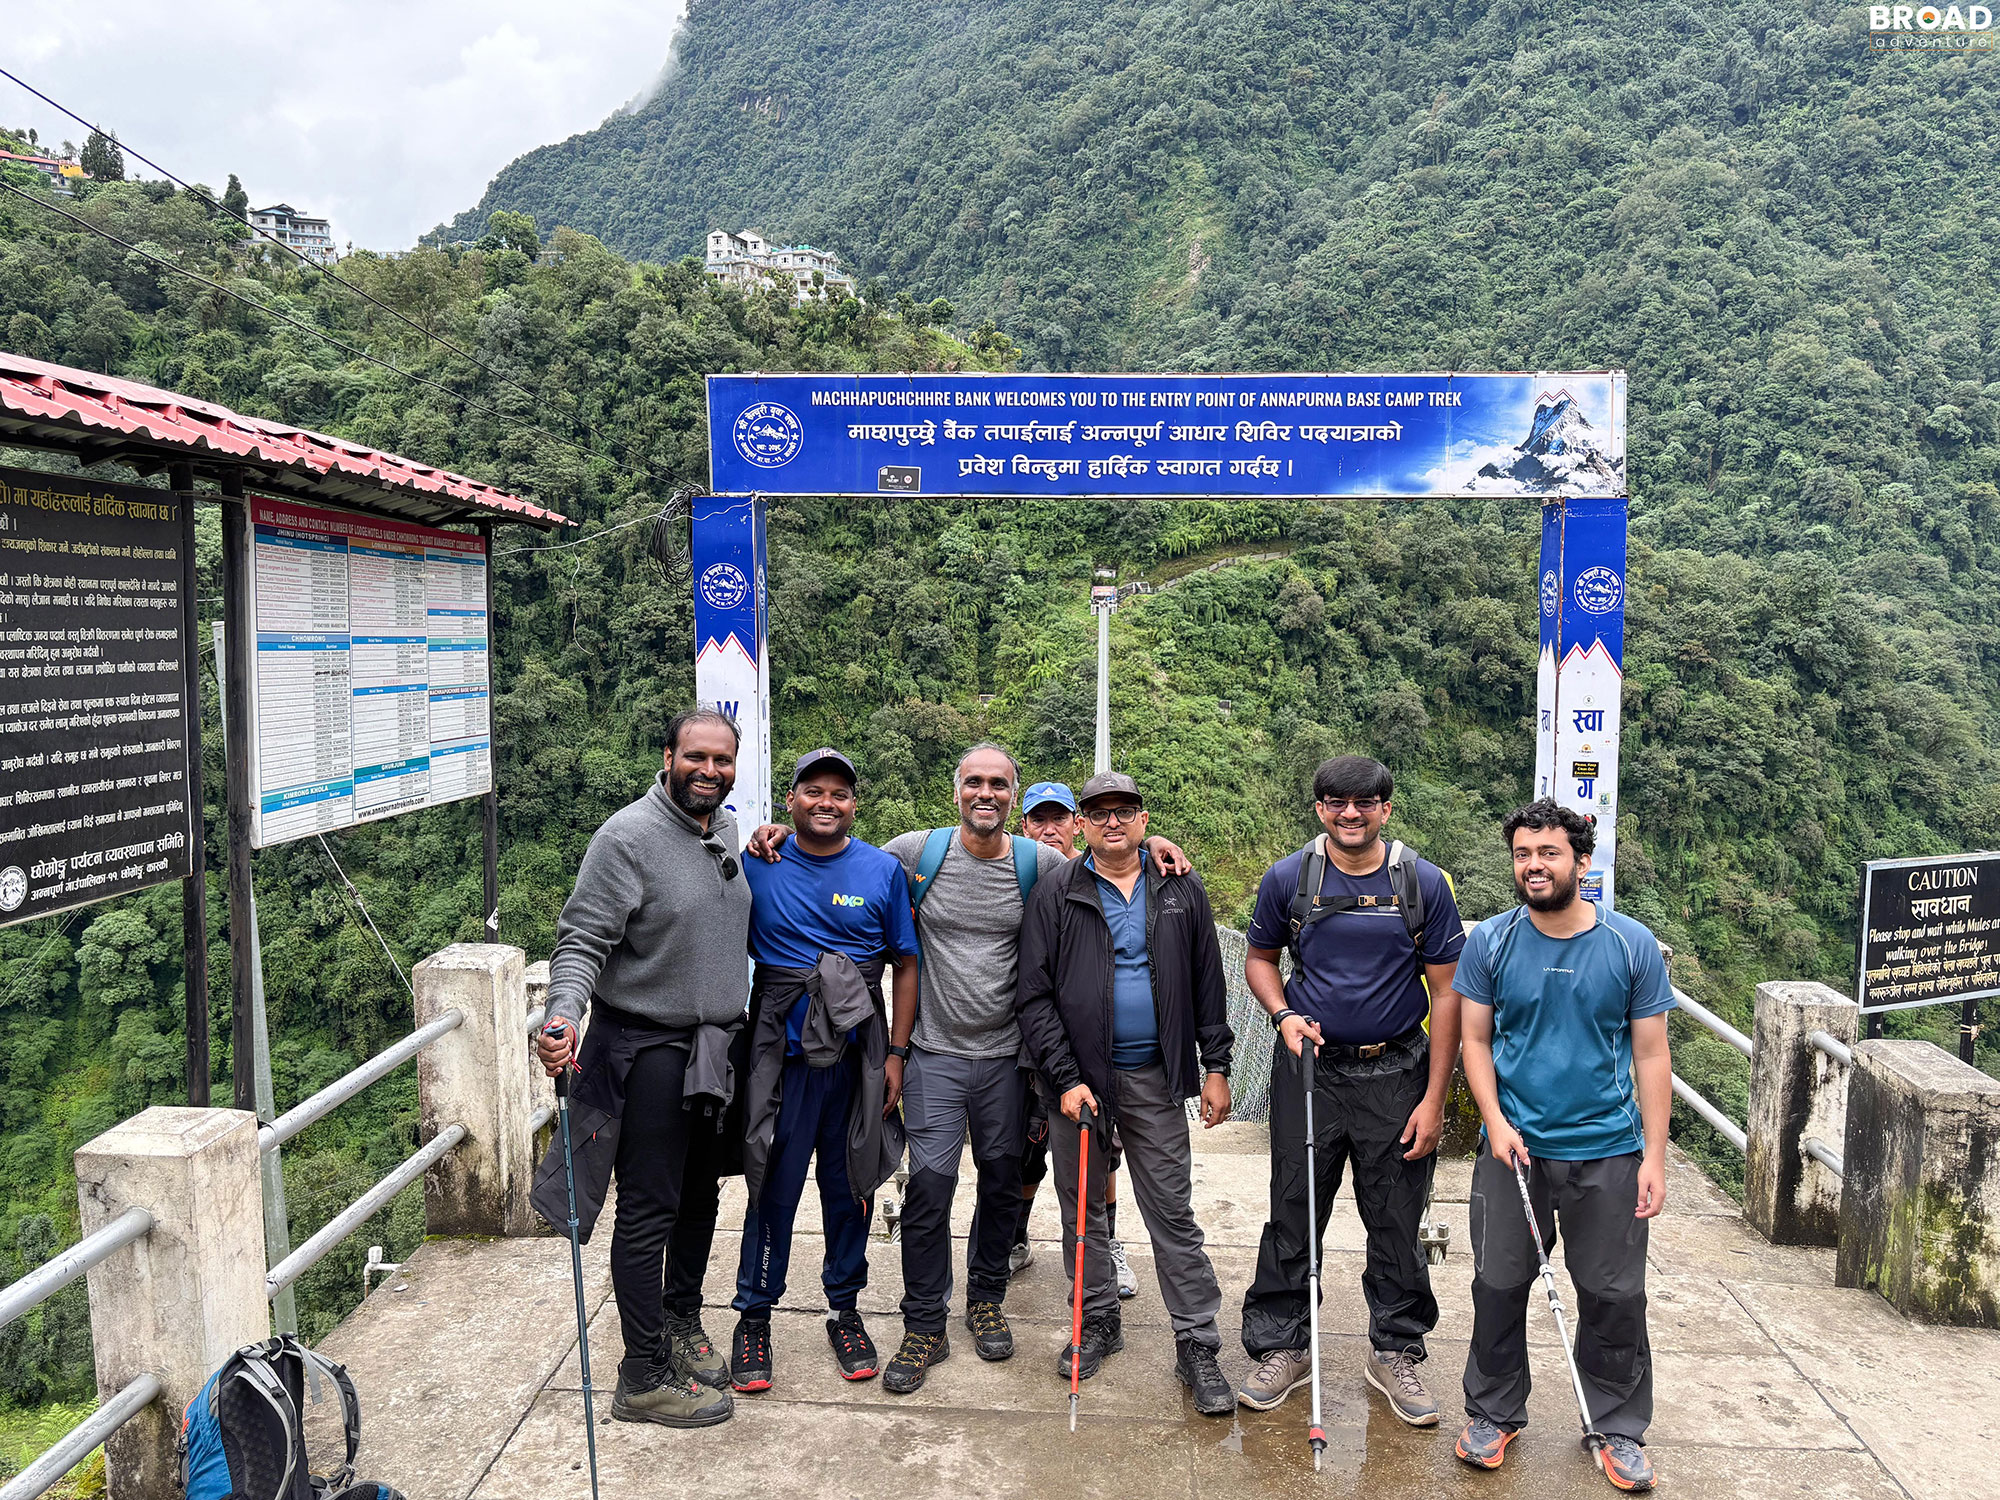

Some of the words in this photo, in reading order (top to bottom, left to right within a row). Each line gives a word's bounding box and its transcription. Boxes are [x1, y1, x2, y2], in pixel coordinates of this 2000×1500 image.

[811, 391, 951, 406] MACHHAPUCHCHHRE
[955, 392, 991, 407] BANK
[995, 392, 1066, 407] WELCOMES
[1069, 392, 1096, 407] YOU
[1100, 392, 1118, 407] TO
[1121, 392, 1147, 407] THE
[1150, 393, 1192, 407] ENTRY
[1197, 393, 1236, 407] POINT
[1239, 392, 1256, 407] OF
[1260, 392, 1343, 407] ANNAPURNA
[1349, 392, 1381, 407] BASE
[1385, 392, 1425, 407] CAMP
[1428, 392, 1462, 407] TREK
[943, 418, 978, 441] बैंक
[984, 420, 1077, 444] तपाईलाई
[1080, 421, 1165, 447] अन्नपूर्ण
[1168, 424, 1229, 441] आधार
[1235, 421, 1293, 442] शिविर
[1299, 420, 1403, 444] पदयात्राको
[958, 454, 1005, 477] प्रवेश
[1011, 454, 1081, 481] बिन्दुमा
[1087, 454, 1150, 478] हार्दिक
[1156, 459, 1222, 476] स्वागत
[1229, 455, 1282, 478] गर्दछ
[13, 487, 28, 506] मा
[93, 493, 125, 517] हार्दिक
[126, 501, 158, 519] स्वागत
[71, 850, 103, 870] पर्यटन
[105, 840, 154, 863] व्यवस्थापन
[156, 831, 185, 853] समिति
[30, 881, 64, 901] अन्नपूर्ण
[1908, 866, 1979, 891] CAUTION
[832, 893, 865, 907] NXP
[1911, 895, 1973, 921] सावधान
[1868, 928, 1892, 944] Please
[1893, 925, 1911, 943] stop
[1911, 923, 1927, 940] and
[1927, 921, 1944, 937] wait
[1945, 920, 1966, 935] while
[1966, 916, 1991, 932] Mules
[1885, 945, 1918, 964] walking
[1920, 944, 1942, 958] over
[1944, 940, 1957, 955] the
[1959, 937, 1988, 957] Bridge!
